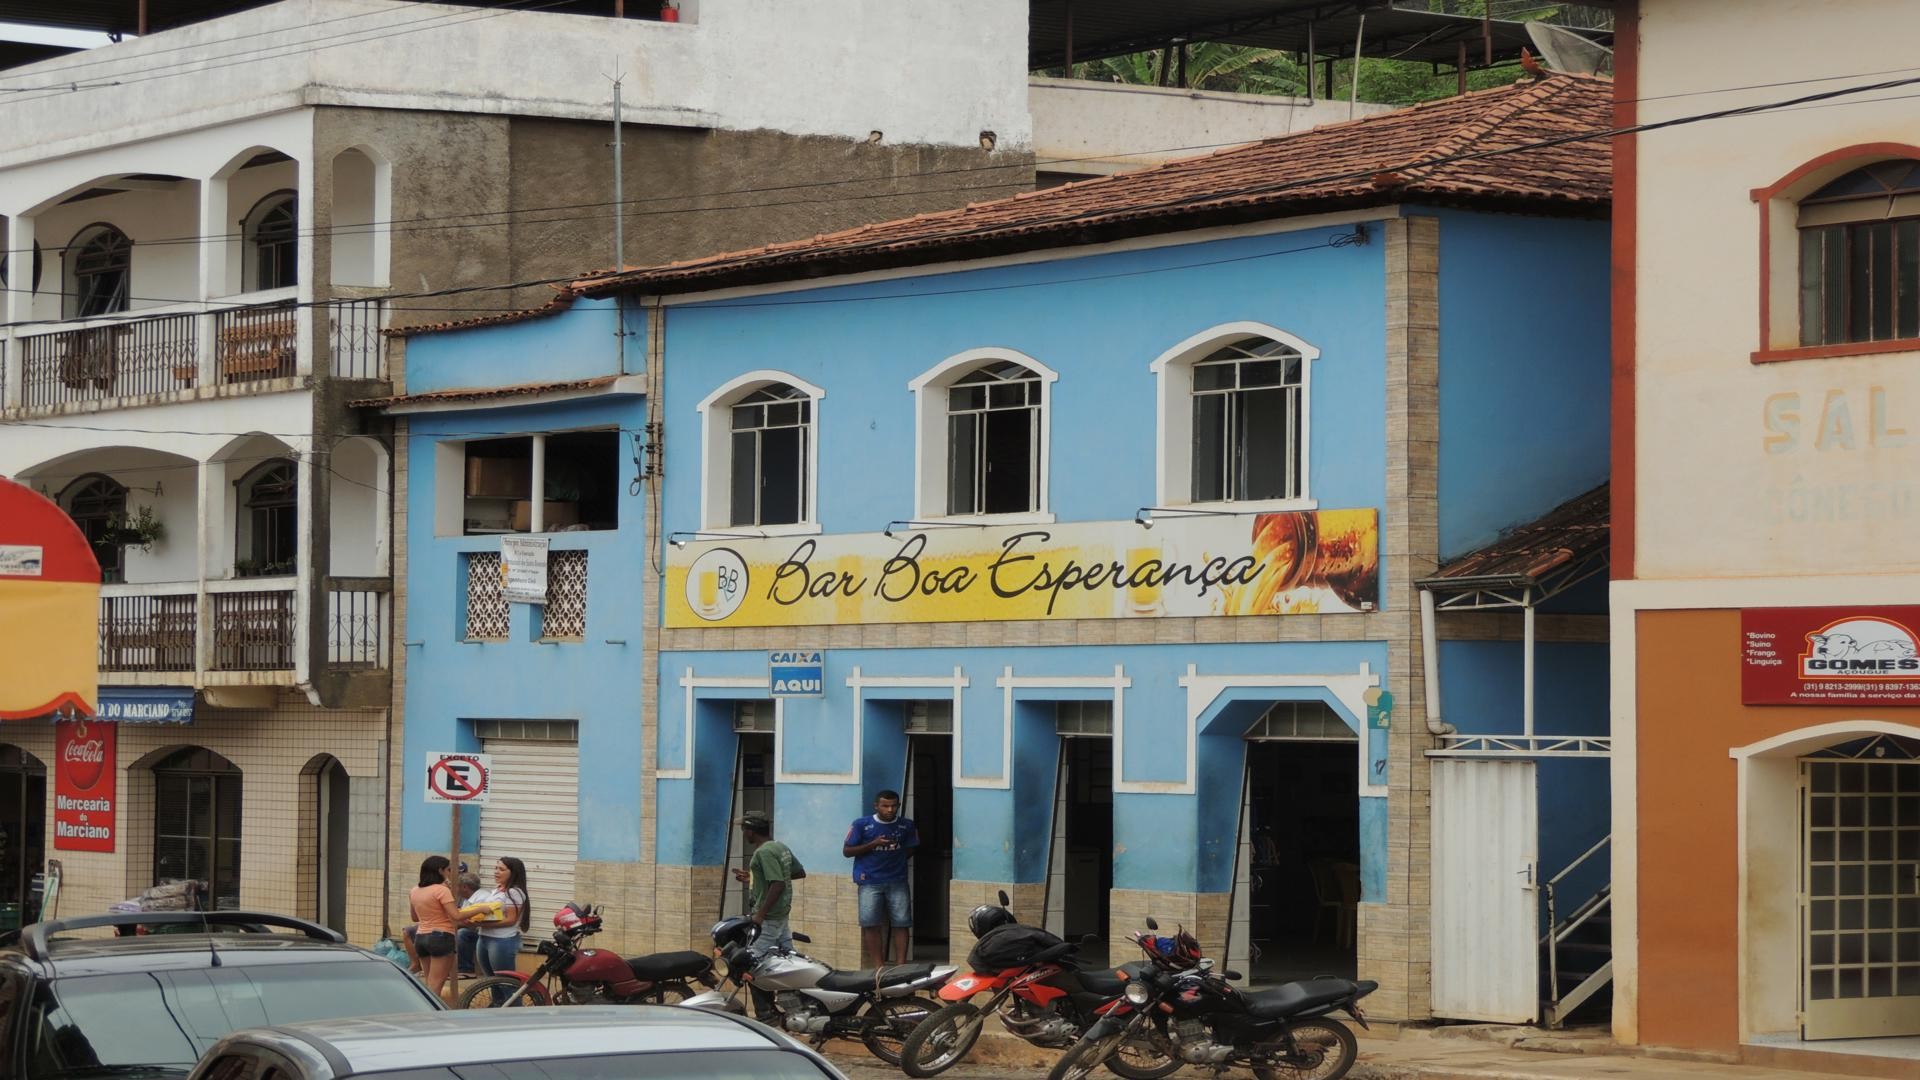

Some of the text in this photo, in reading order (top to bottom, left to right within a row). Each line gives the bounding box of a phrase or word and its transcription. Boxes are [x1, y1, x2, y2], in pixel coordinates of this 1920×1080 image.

[767, 531, 1266, 616] Bar Boa Esperança
[770, 652, 822, 663] CAIXA
[1808, 659, 1919, 670] GOMES
[774, 679, 820, 691] AQUI
[108, 702, 122, 717] DO
[123, 702, 170, 718] MARCIANO
[57, 795, 111, 812] Mercearia
[79, 812, 88, 821] do
[57, 821, 110, 839] Marciano
